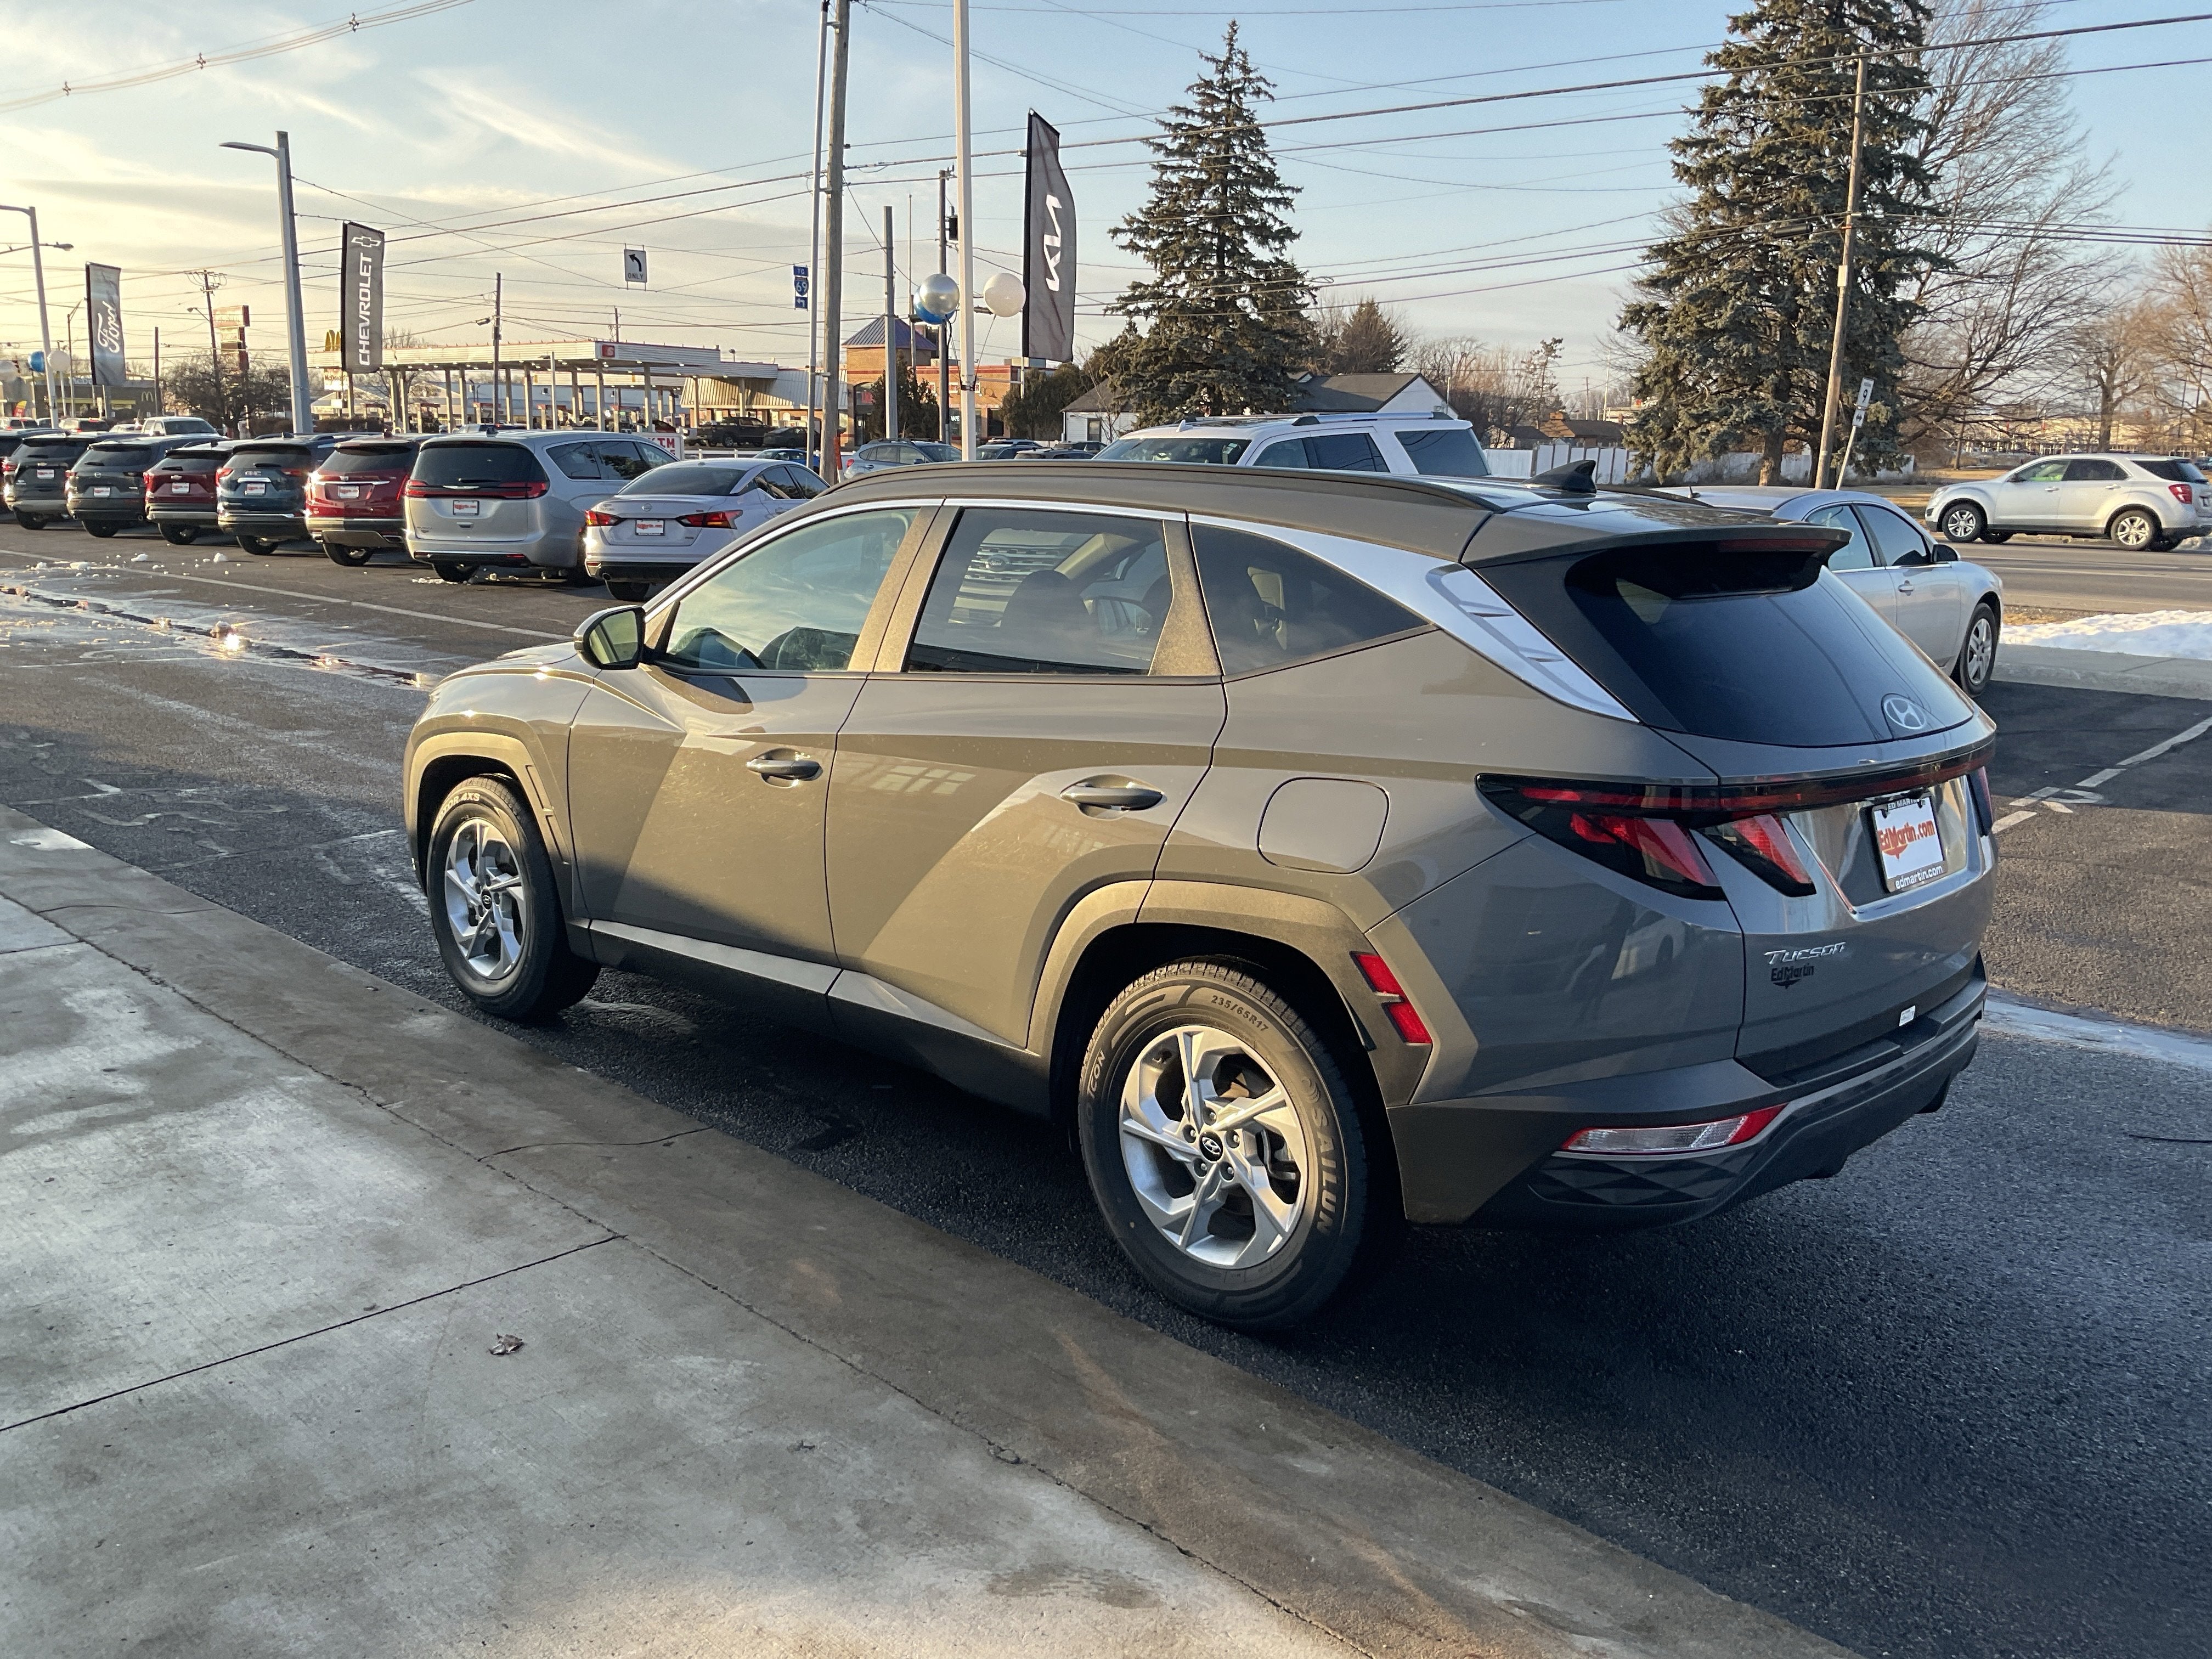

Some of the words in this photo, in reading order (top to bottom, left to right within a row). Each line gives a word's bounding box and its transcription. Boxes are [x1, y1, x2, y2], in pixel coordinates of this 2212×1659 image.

[796, 281, 808, 293] 69
[98, 301, 120, 353] Ford
[358, 252, 373, 366] CHEVROLET
[1862, 389, 1868, 403] 9
[1895, 865, 1943, 889] edmartin.com
[1211, 995, 1269, 1031] 235/65R17
[1312, 1107, 1338, 1234] SAILUN
